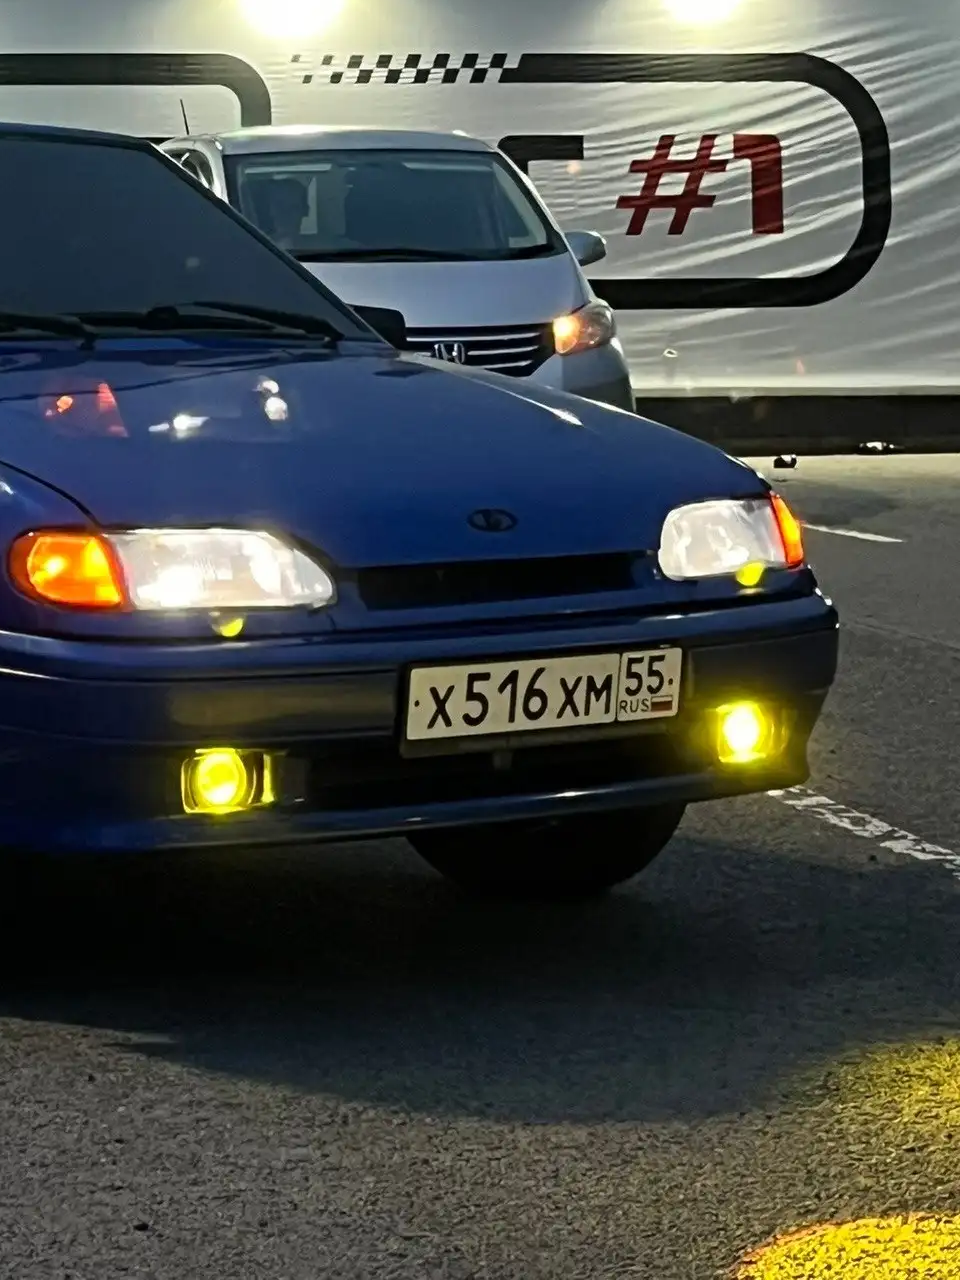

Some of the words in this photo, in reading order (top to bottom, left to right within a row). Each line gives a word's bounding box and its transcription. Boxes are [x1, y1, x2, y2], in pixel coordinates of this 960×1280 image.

[615, 133, 784, 236] #1
[427, 666, 614, 730] Х516ХМ
[625, 654, 666, 697] 55
[619, 697, 649, 714] RUS
